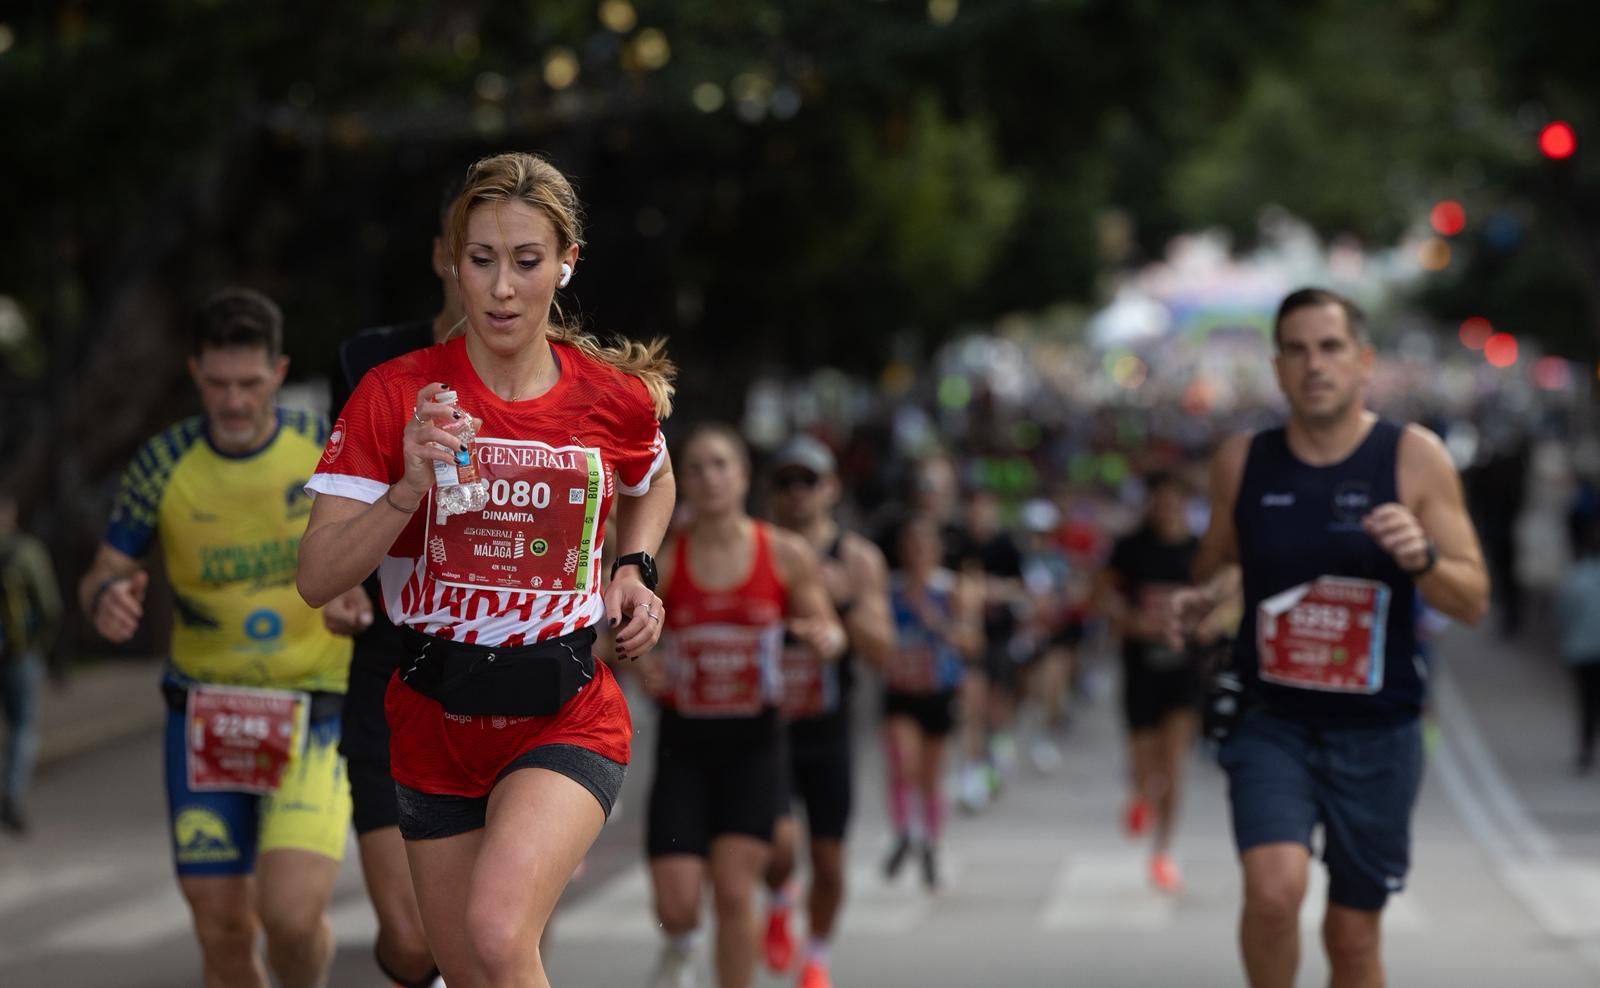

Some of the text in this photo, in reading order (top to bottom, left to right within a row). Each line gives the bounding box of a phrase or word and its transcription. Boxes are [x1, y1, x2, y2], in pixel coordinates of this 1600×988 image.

[478, 446, 577, 469] GENERALI
[588, 480, 599, 499] BOX
[482, 511, 534, 522] DINAMITA
[475, 528, 512, 538] GENERALI
[474, 542, 512, 559] MÁLAGA
[579, 547, 589, 567] BOX
